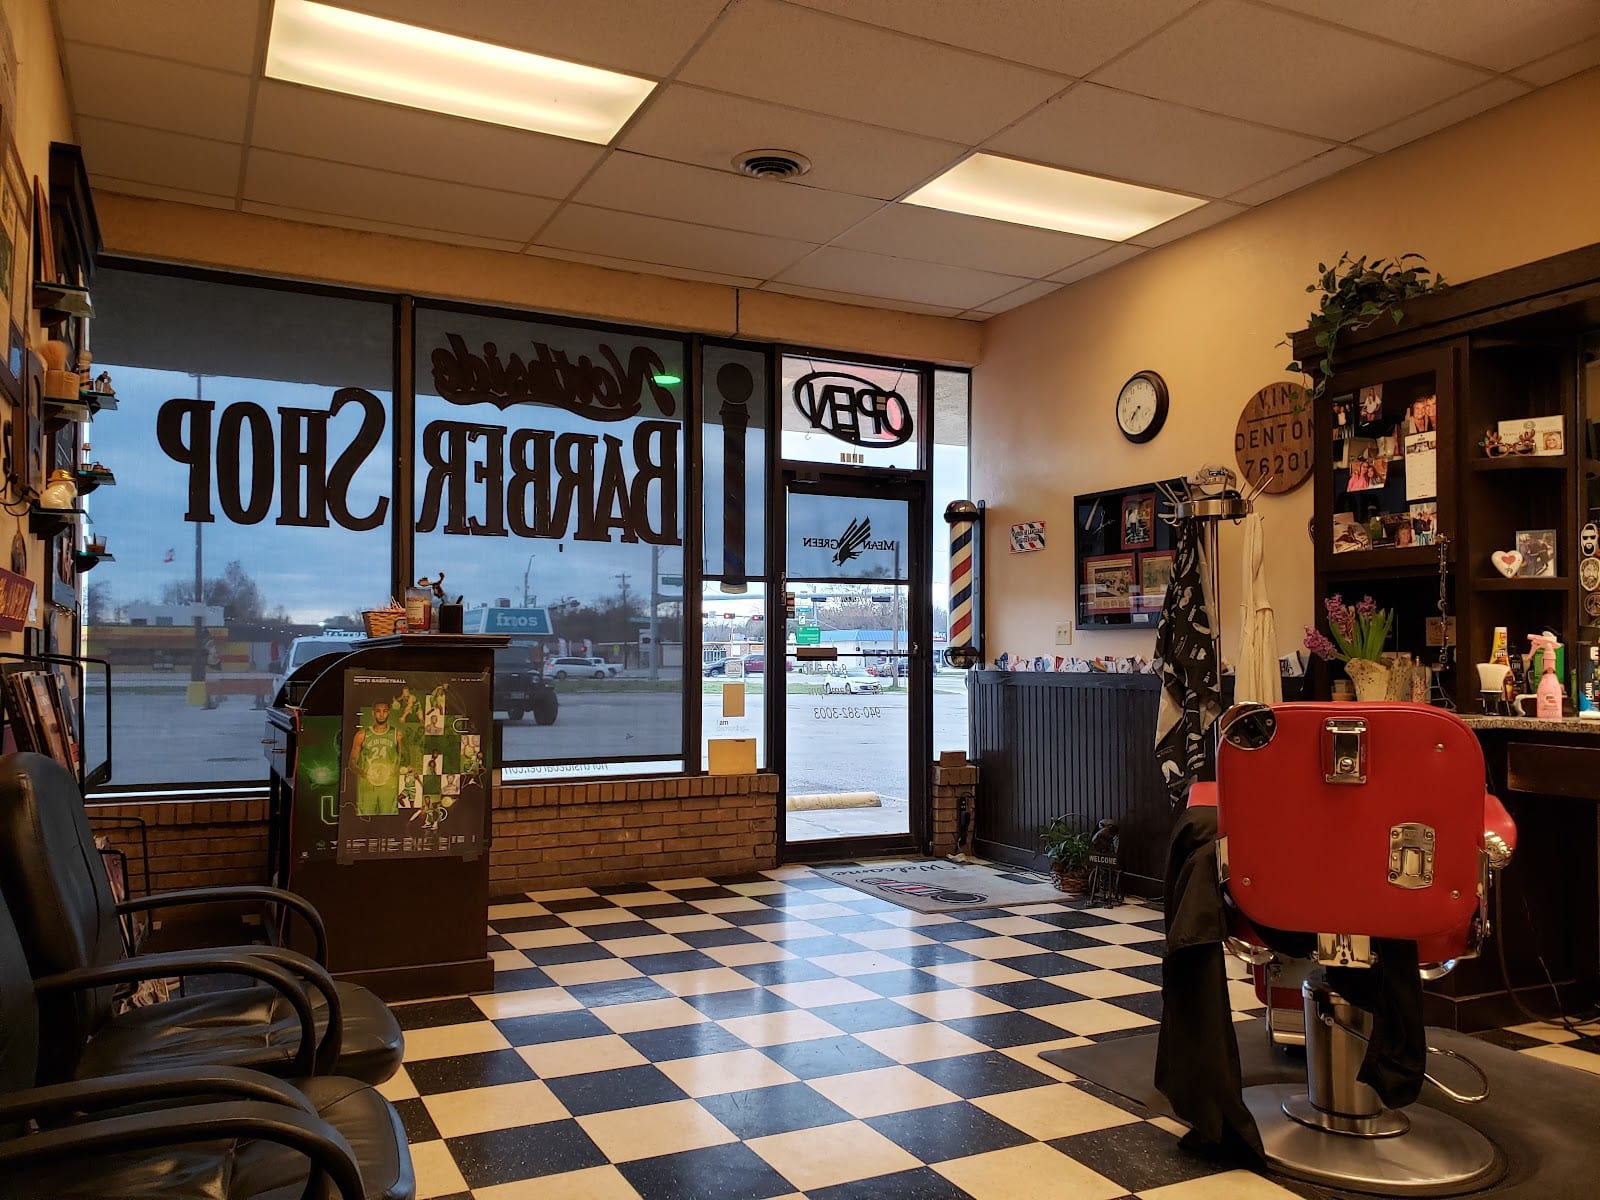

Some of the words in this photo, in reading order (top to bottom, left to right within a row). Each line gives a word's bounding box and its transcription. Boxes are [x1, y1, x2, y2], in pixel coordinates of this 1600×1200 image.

[1244, 448, 1310, 480] 76201
[371, 746, 387, 759] 24
[1088, 854, 1118, 866] WELCOME
